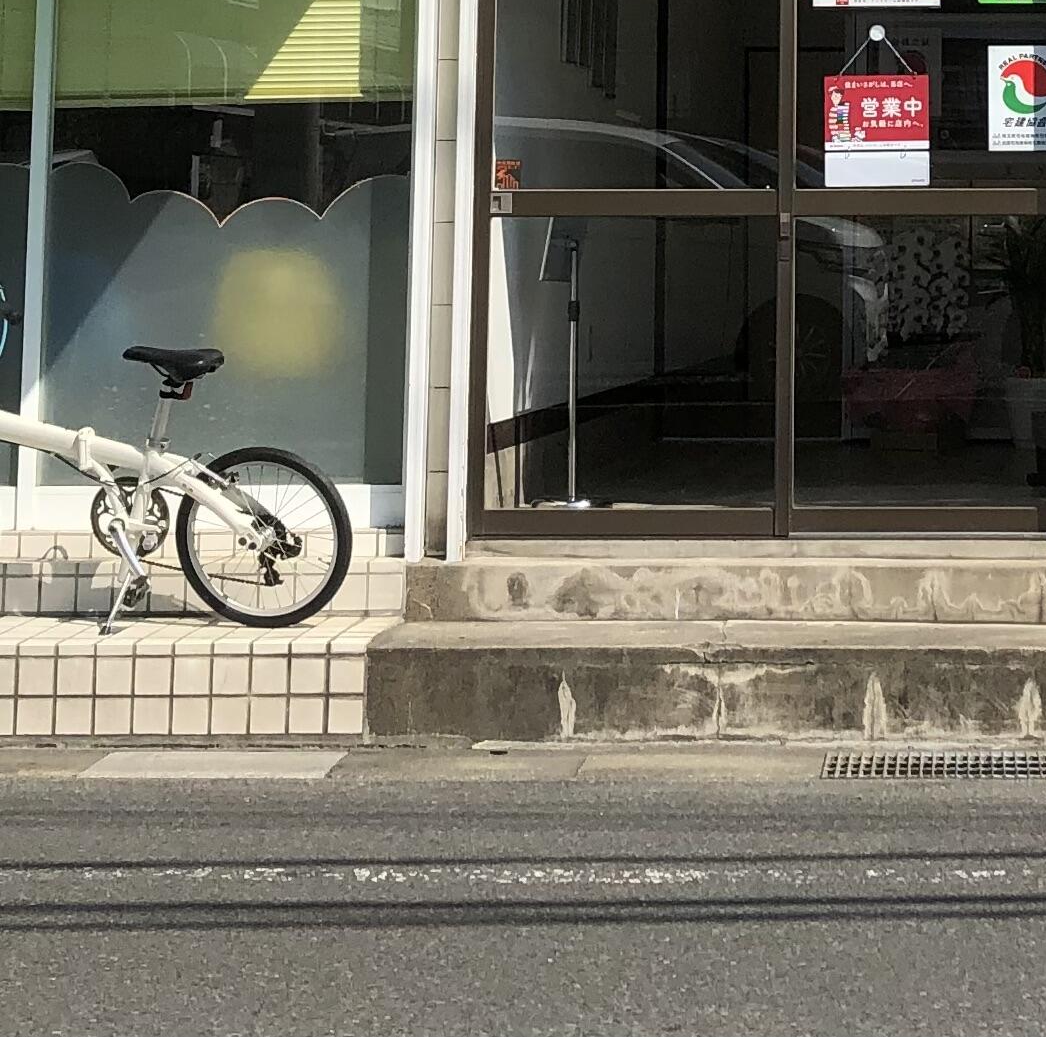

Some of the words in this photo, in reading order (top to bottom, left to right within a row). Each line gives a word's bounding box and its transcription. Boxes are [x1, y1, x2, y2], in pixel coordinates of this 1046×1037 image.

[998, 55, 1018, 71] REAL
[860, 96, 923, 118] 営業中
